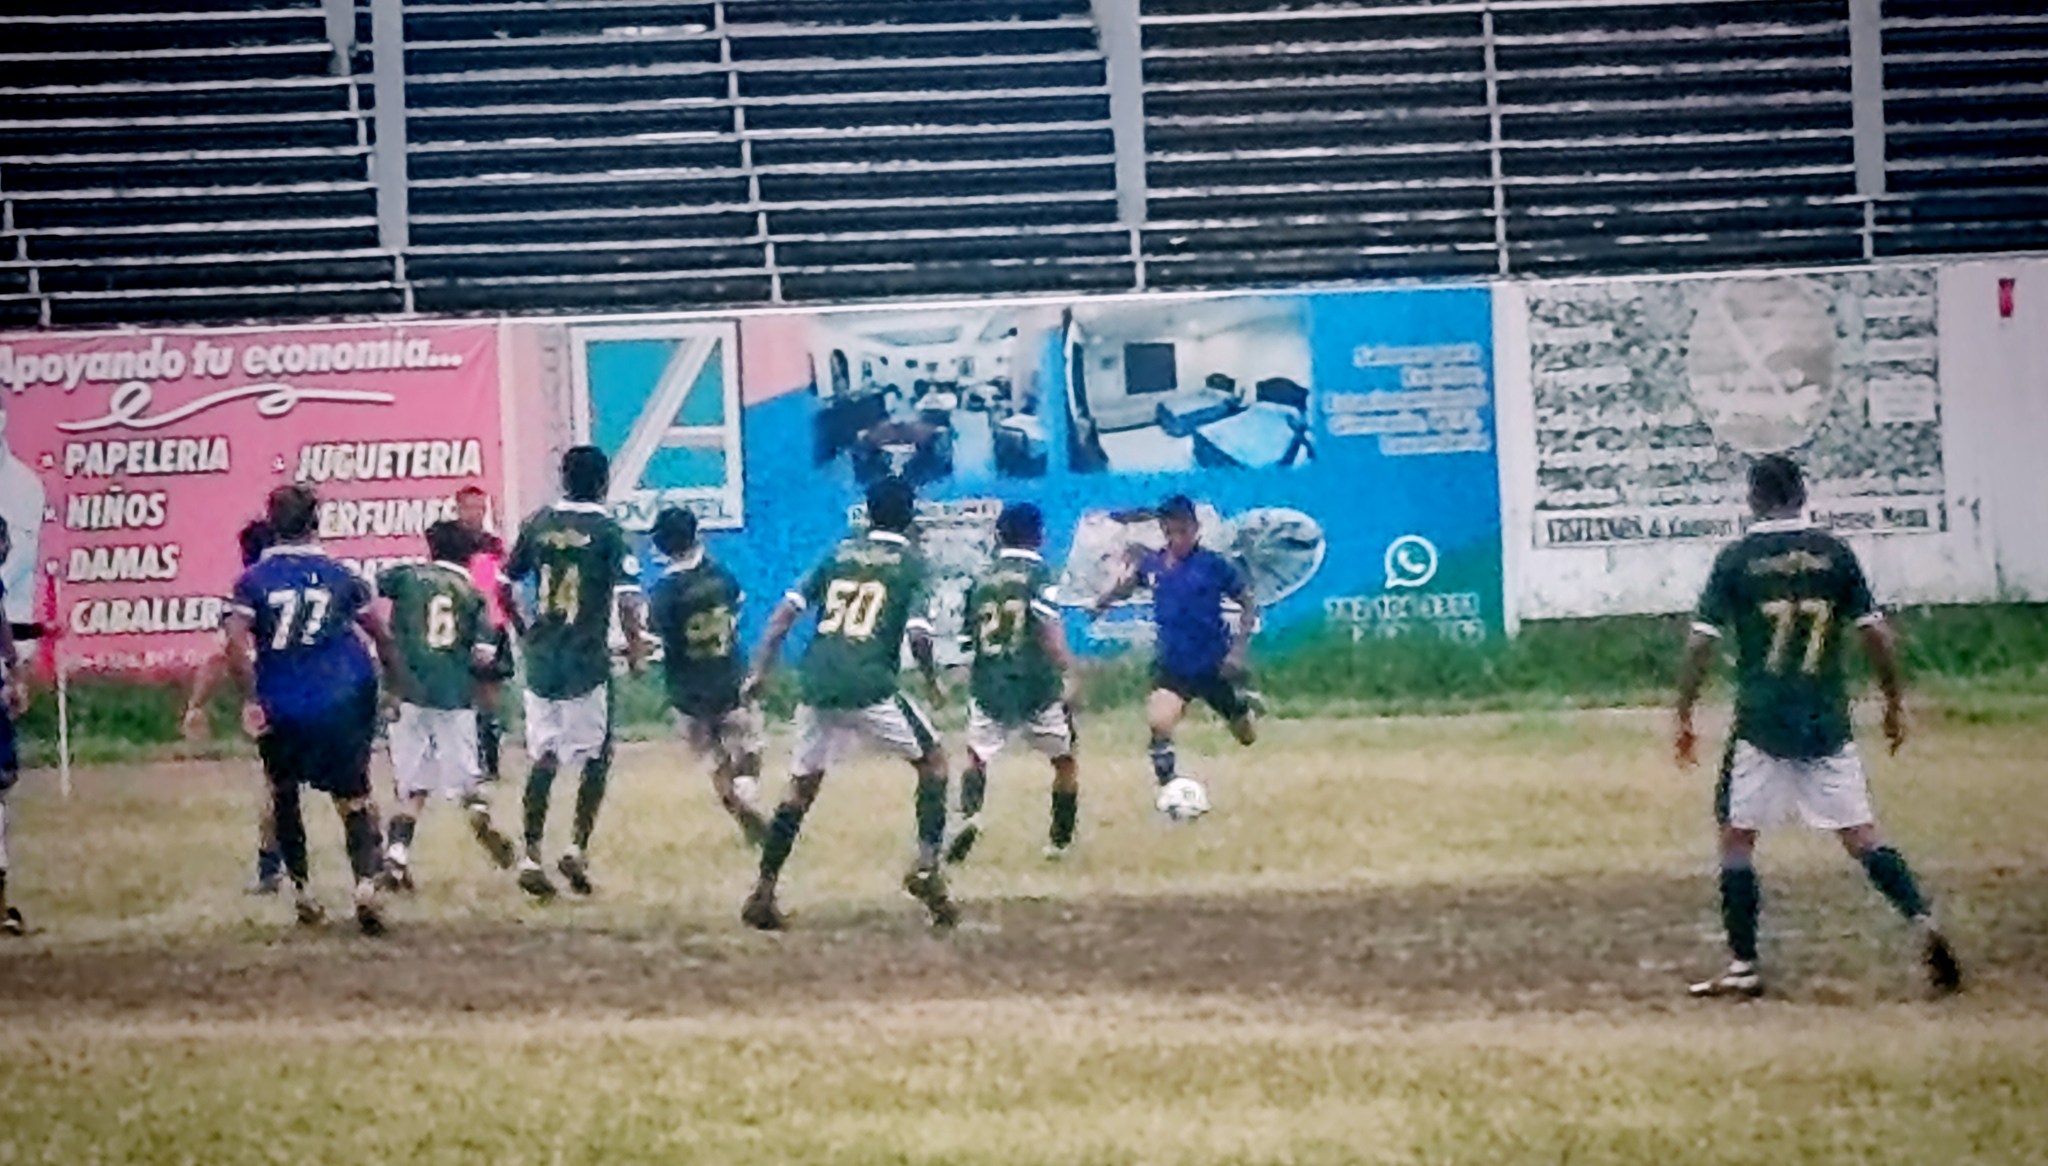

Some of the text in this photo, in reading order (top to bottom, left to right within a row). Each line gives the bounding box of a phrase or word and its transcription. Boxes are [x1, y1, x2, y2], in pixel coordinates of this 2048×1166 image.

[193, 340, 234, 378] tu
[64, 437, 231, 478] PAPELERIA
[294, 439, 483, 483] JUGUETERIA
[66, 484, 168, 530] NIÑOS
[67, 542, 181, 583] DAMAS
[266, 587, 332, 650] 77
[426, 594, 458, 649] 6
[817, 579, 887, 641] 50
[1759, 599, 1834, 675] 77
